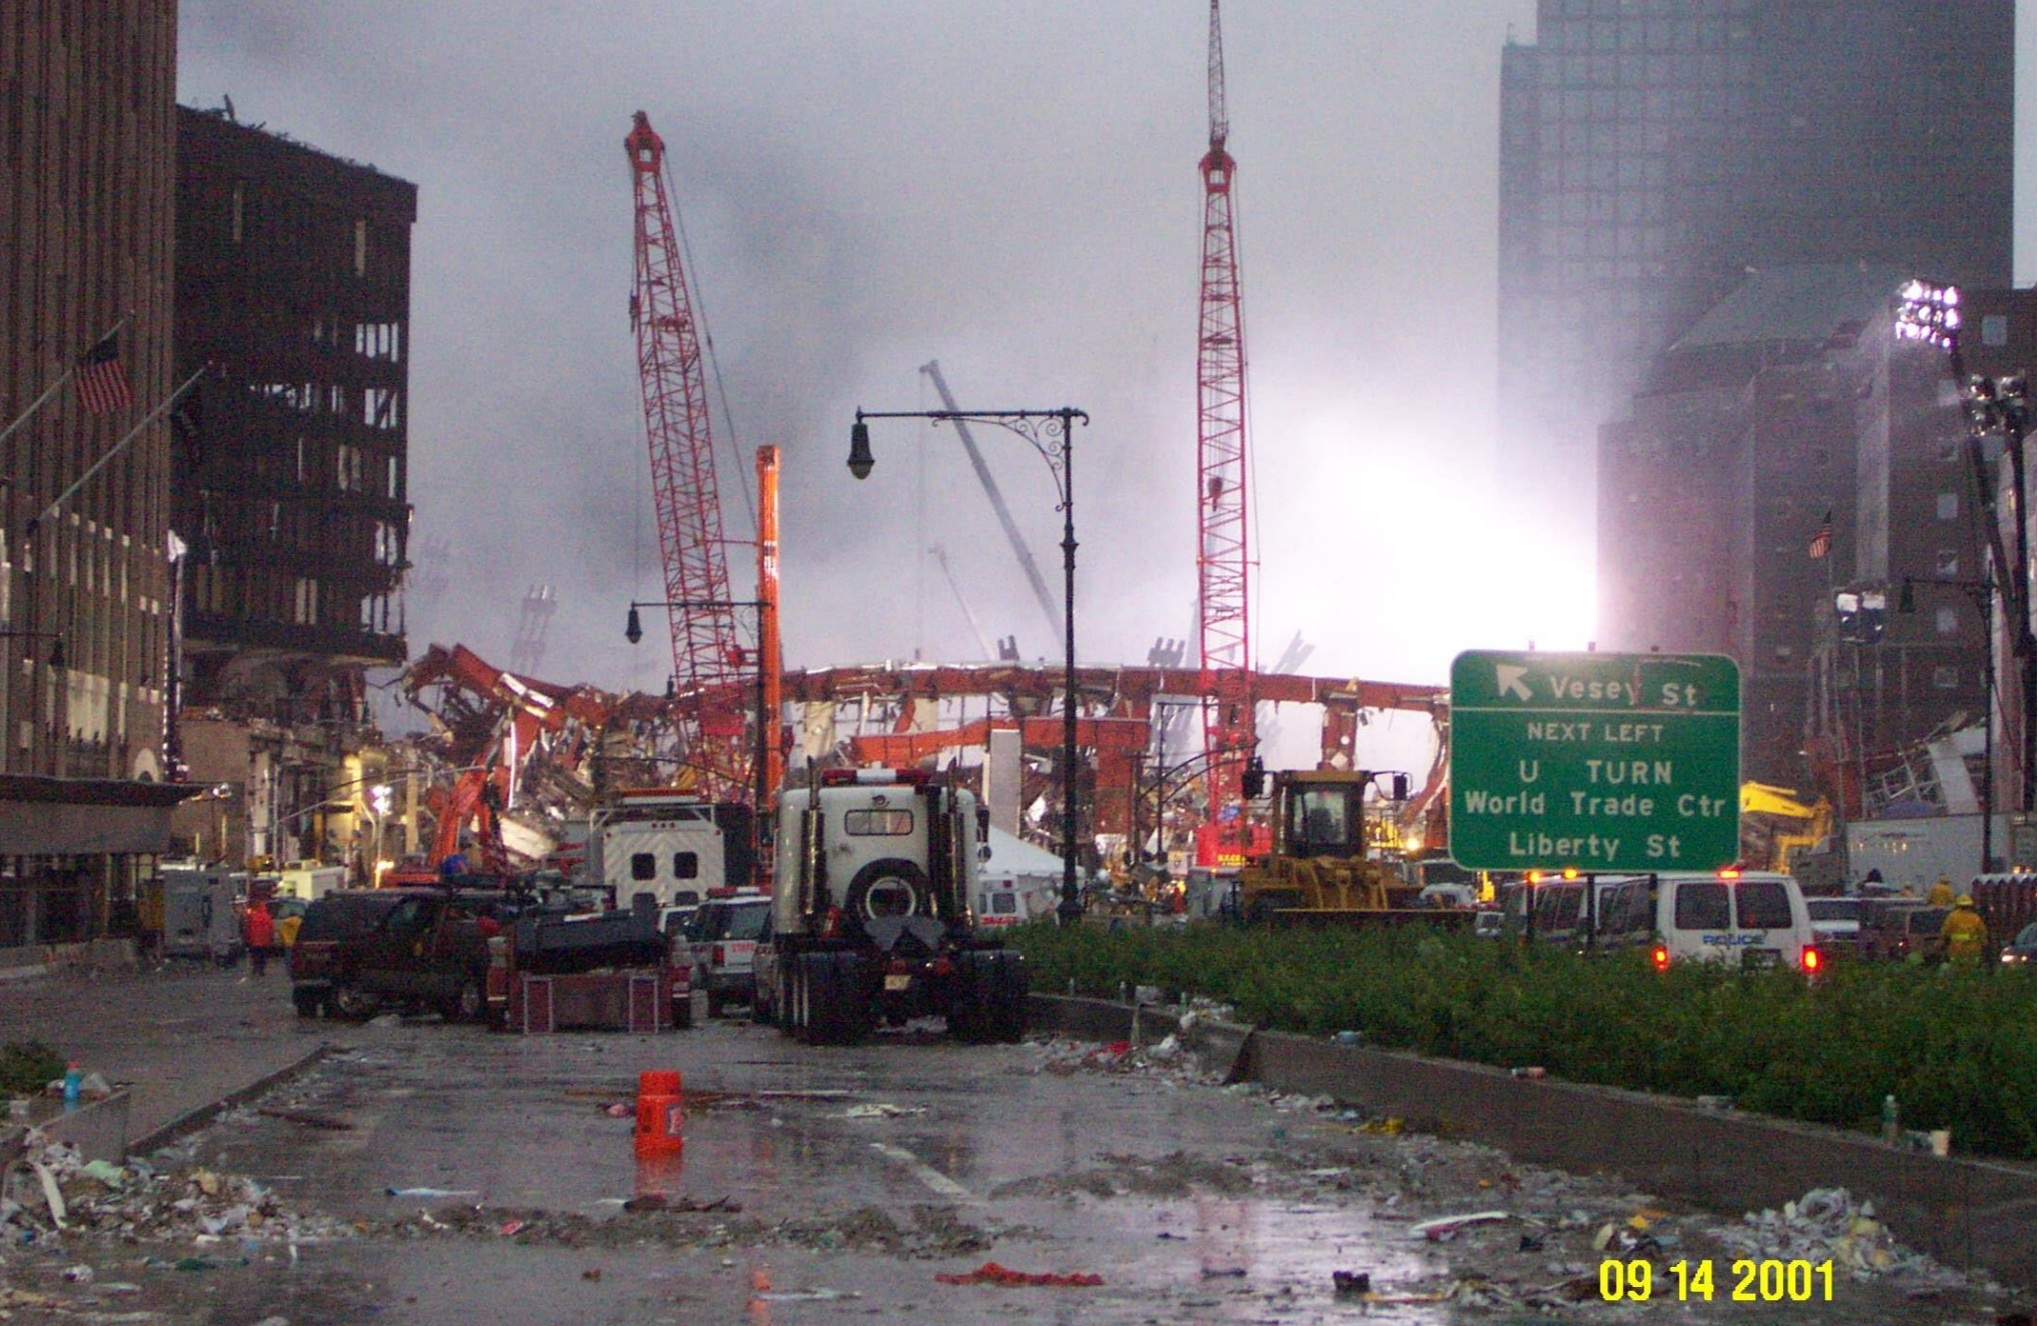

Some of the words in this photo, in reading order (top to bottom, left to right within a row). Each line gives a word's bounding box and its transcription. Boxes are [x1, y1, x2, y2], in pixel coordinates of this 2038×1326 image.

[1550, 675, 1642, 706] Vesey
[1662, 682, 1697, 706] St
[1527, 722, 1591, 741] NEXT
[1605, 723, 1664, 743] LEFT
[1519, 759, 1539, 783] U
[1586, 759, 1672, 785] TURN
[1464, 790, 1546, 815] World
[1570, 791, 1654, 816] Trade
[1677, 794, 1726, 817] Ctr
[1509, 832, 1620, 862] Liberty
[1646, 834, 1681, 858] St
[1703, 935, 1765, 946] POLICE
